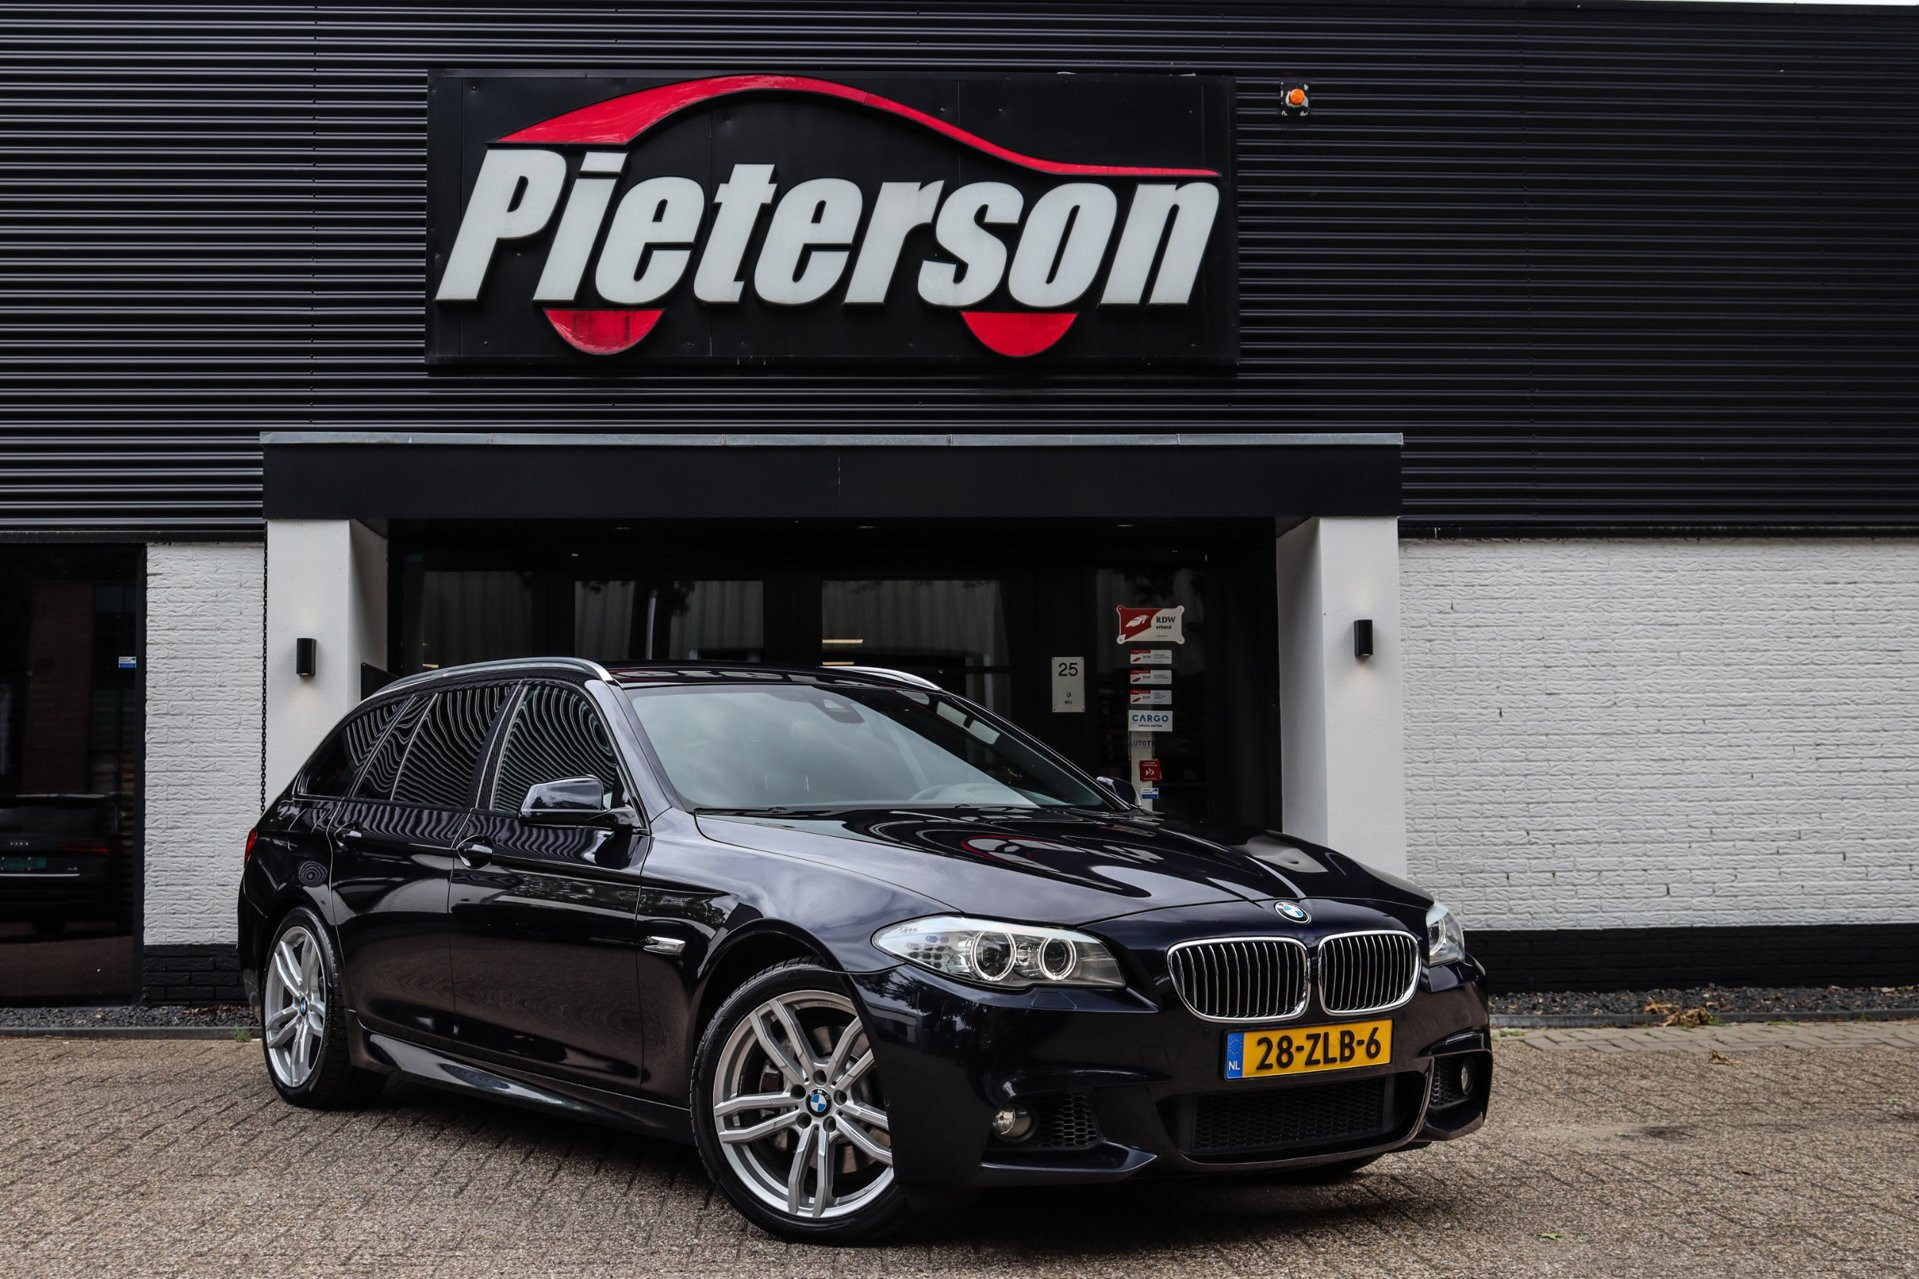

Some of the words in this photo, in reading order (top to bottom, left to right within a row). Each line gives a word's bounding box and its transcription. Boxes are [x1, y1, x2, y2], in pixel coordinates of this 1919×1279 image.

[435, 148, 1220, 307] Pieterson
[1156, 616, 1176, 624] RDW
[1058, 662, 1078, 677] 25
[1132, 714, 1169, 723] CARGO
[1256, 1026, 1381, 1071] 28-ZLB-6
[1228, 1061, 1241, 1071] NL
